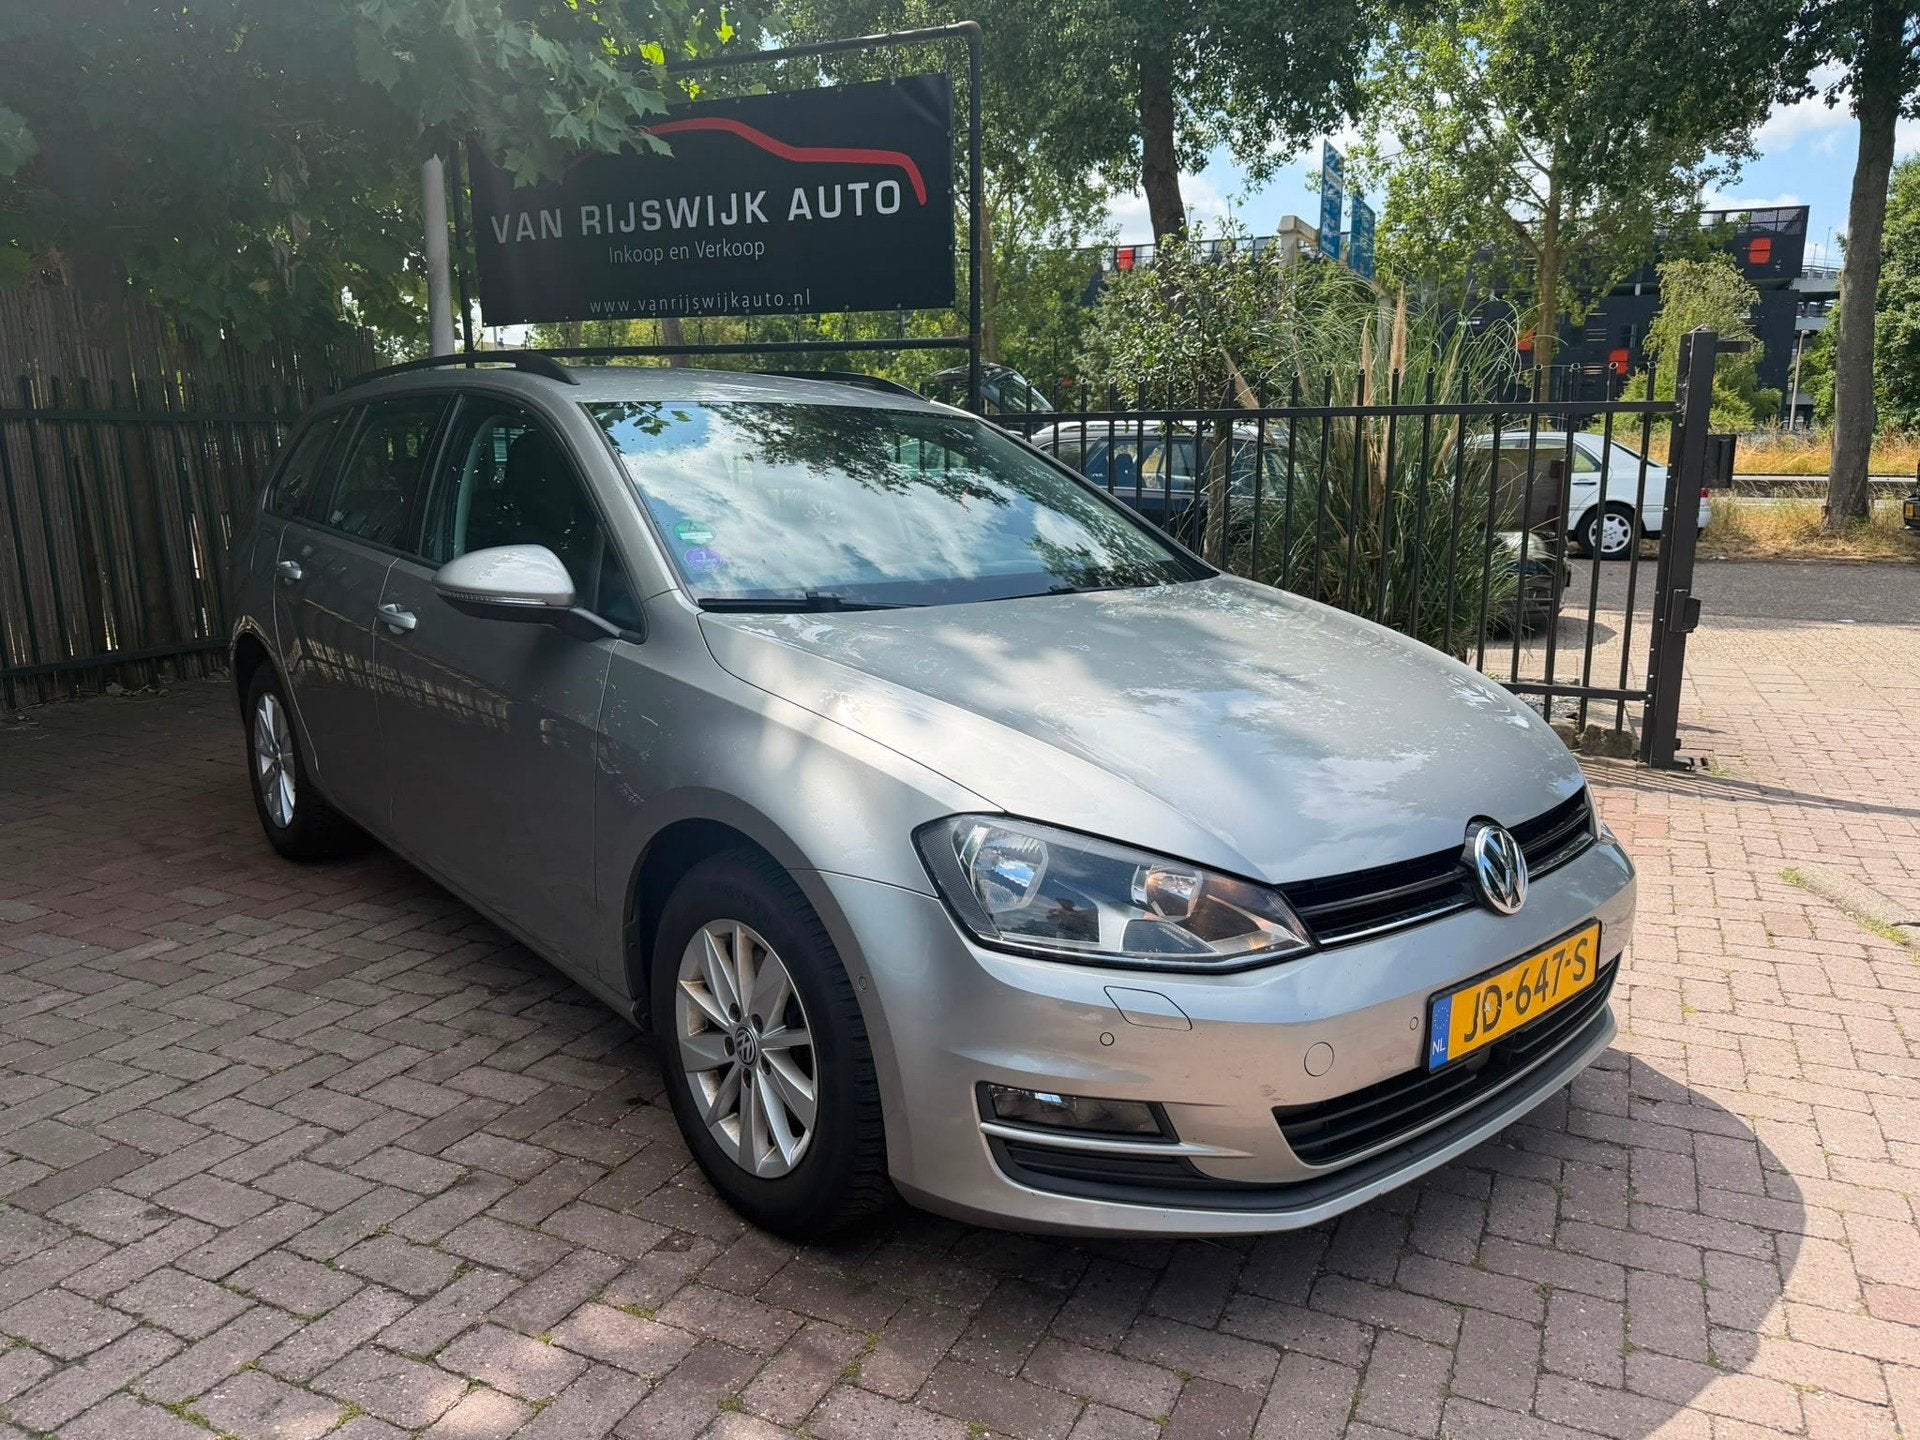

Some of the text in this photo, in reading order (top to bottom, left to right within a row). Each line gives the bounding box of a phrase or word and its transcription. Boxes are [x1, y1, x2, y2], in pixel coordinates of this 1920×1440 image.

[490, 179, 901, 244] VAN RIJSWIJK AUTO
[608, 238, 765, 265] Inkoop en Verkoop
[589, 288, 811, 314] www.vanrijswijkauto.nl
[1463, 937, 1588, 1043] JD-647-S
[1432, 1039, 1446, 1055] NL
